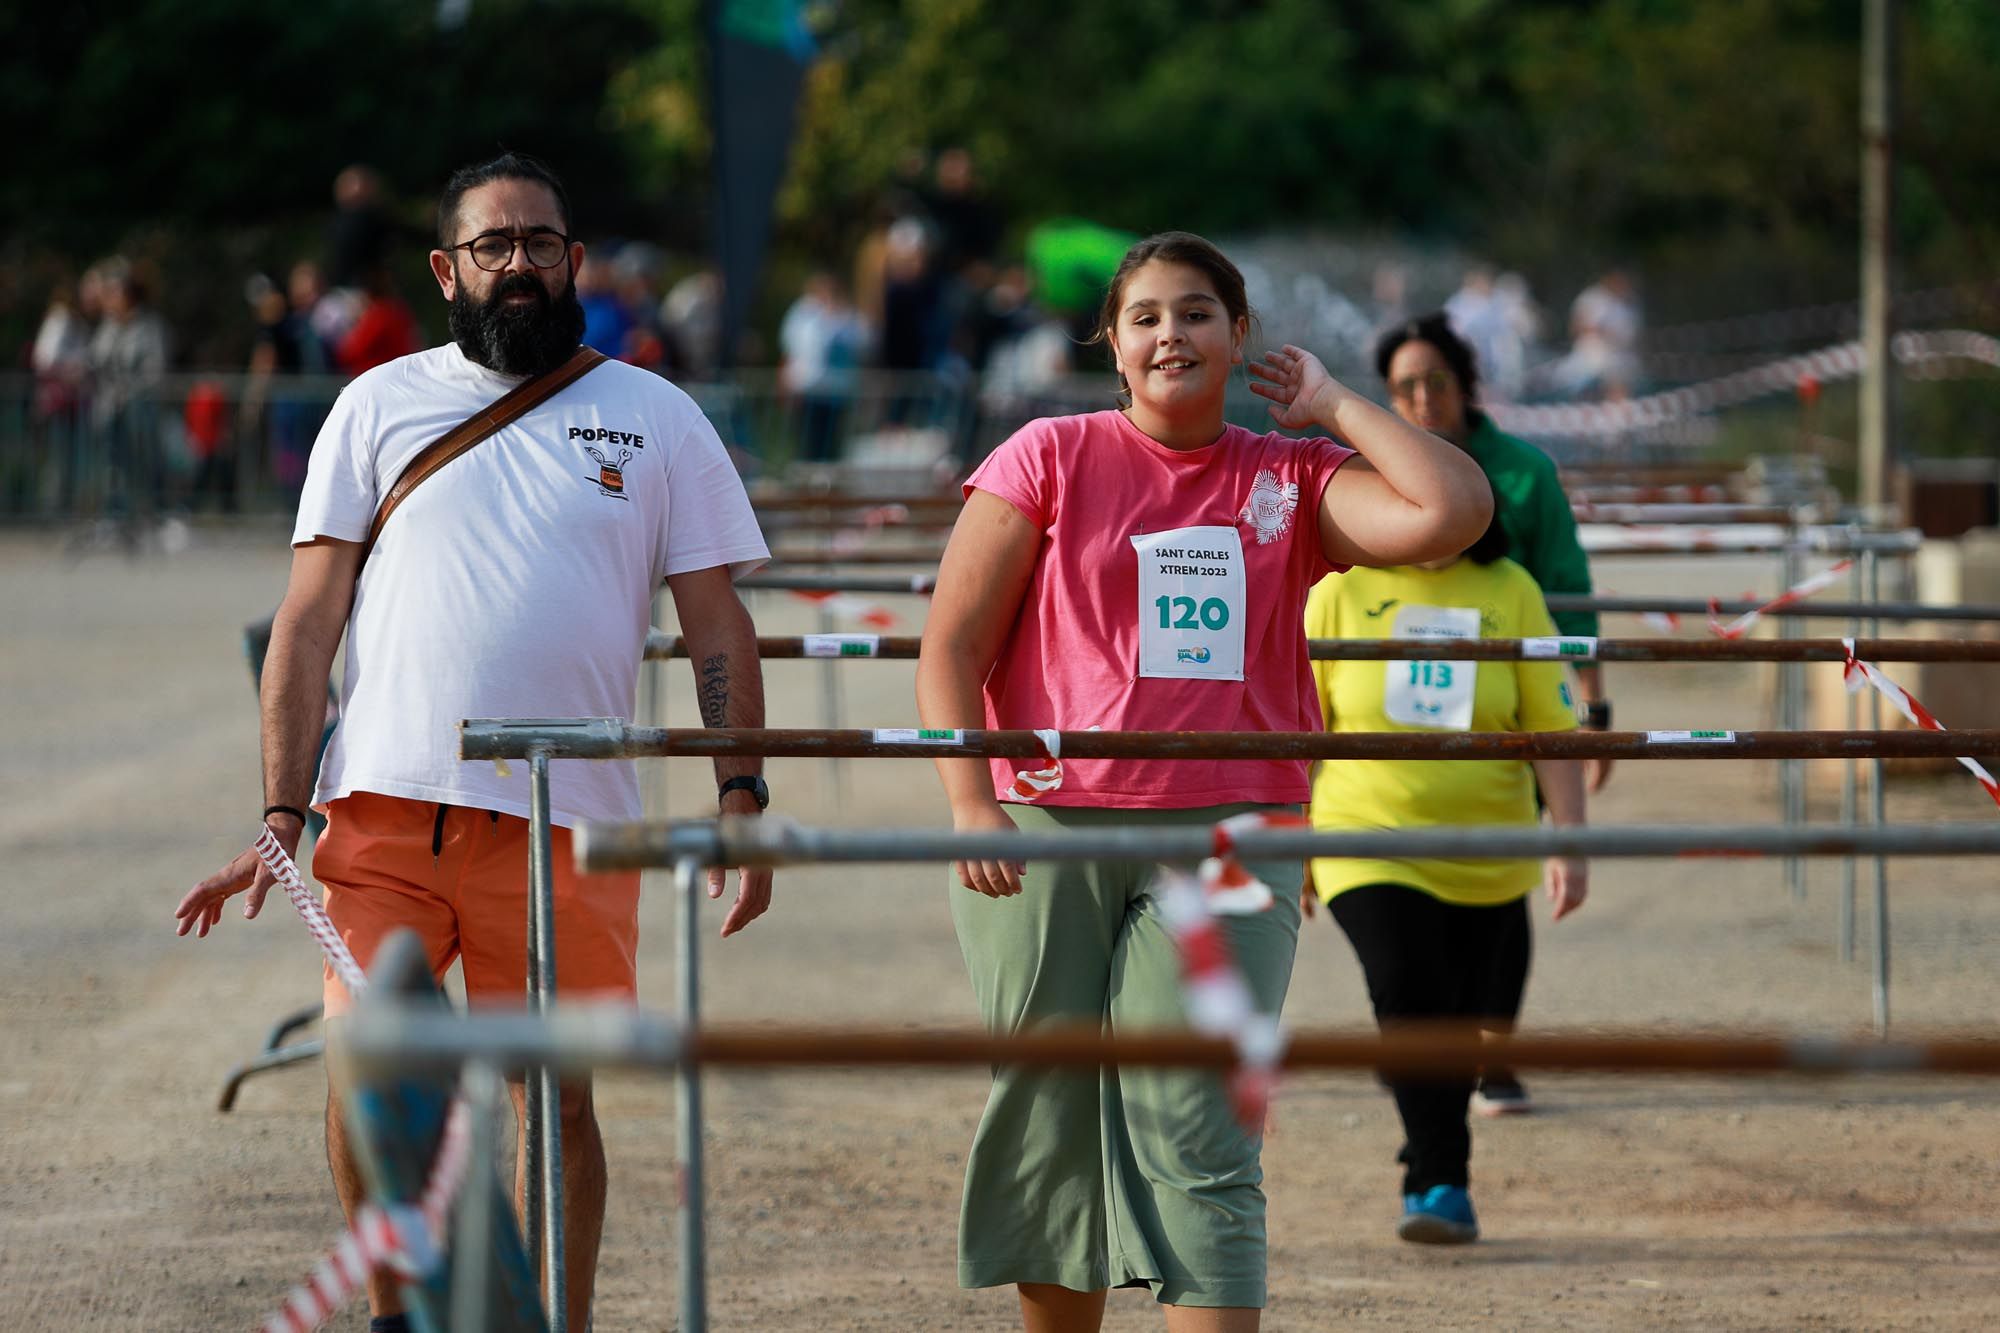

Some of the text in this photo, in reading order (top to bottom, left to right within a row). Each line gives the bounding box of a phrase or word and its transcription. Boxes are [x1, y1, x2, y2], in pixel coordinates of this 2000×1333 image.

[568, 427, 645, 449] POPEYE
[1155, 547, 1230, 561] SANT CARLES
[1160, 564, 1228, 577] XTREM 2023
[1154, 595, 1230, 631] 120
[1408, 660, 1454, 688] 113
